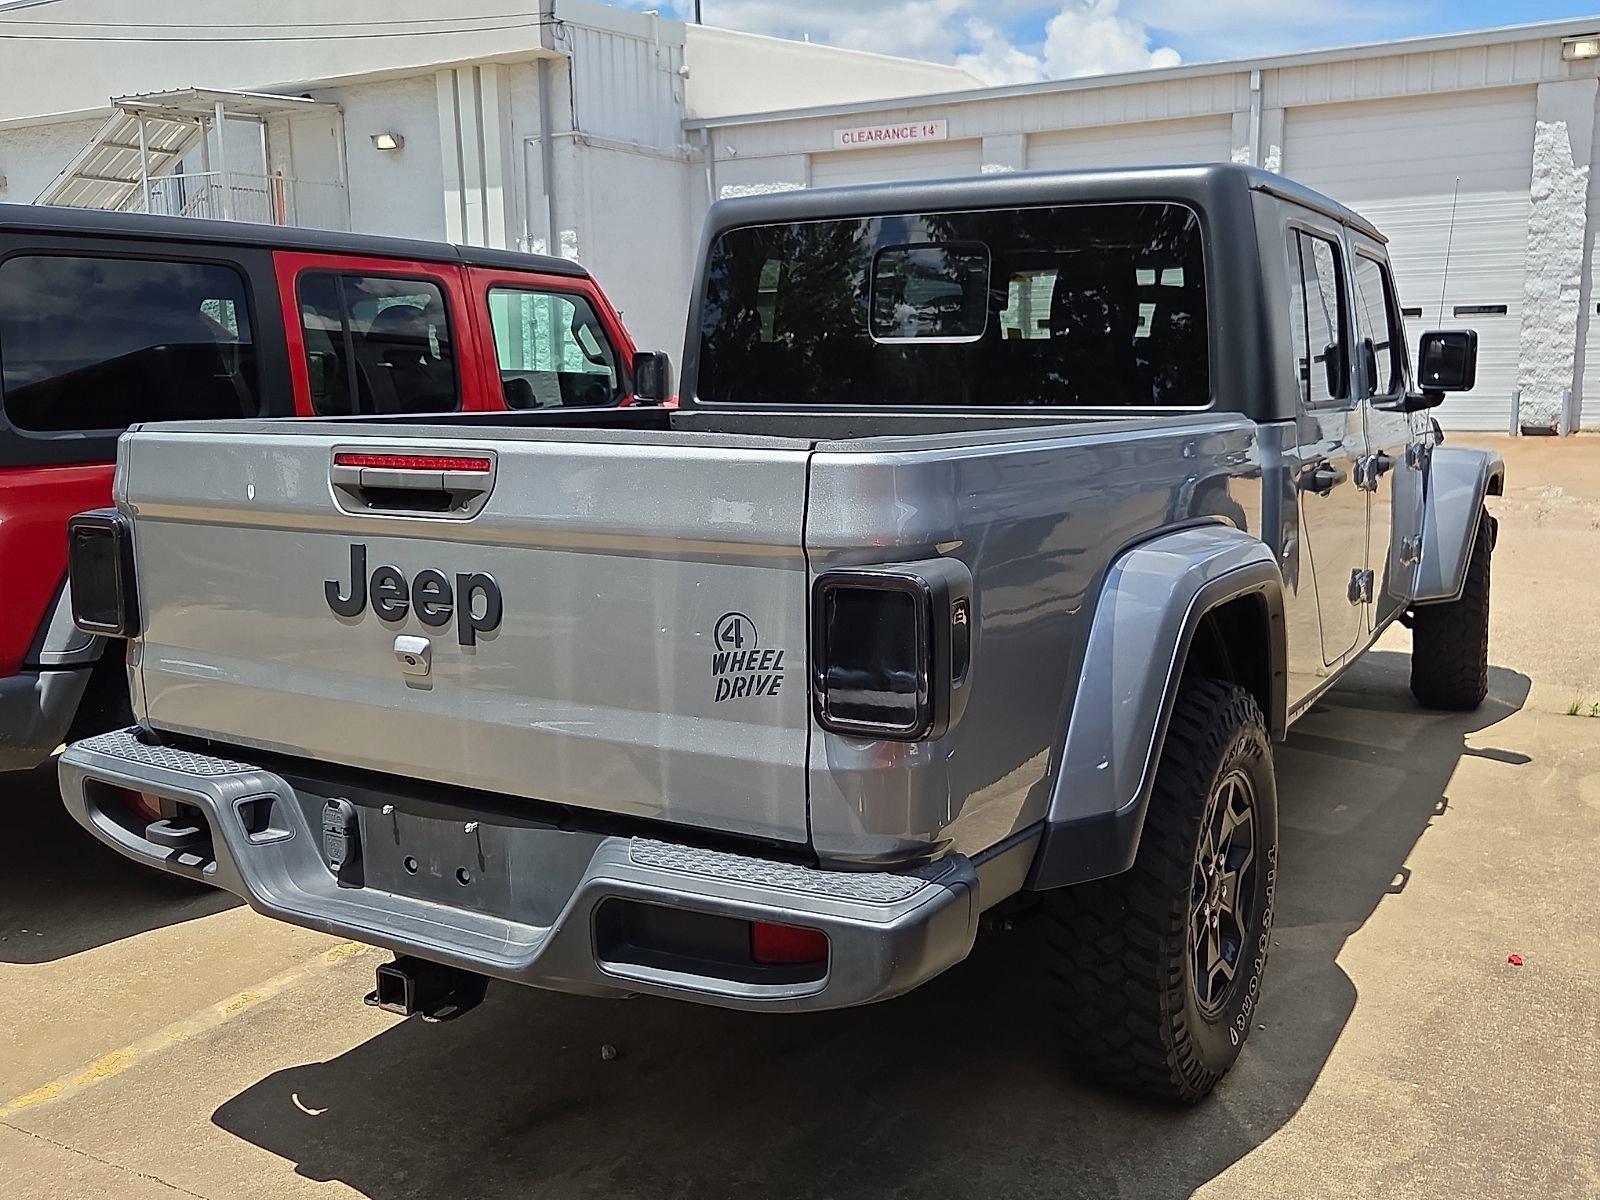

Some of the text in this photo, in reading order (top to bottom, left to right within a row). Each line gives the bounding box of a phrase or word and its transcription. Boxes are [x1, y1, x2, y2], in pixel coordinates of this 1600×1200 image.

[842, 127, 917, 144] CLEARANCE
[324, 543, 502, 646] Jeep
[721, 618, 744, 649] 4
[712, 649, 784, 676] WHEEL
[714, 674, 784, 703] DRIVE
